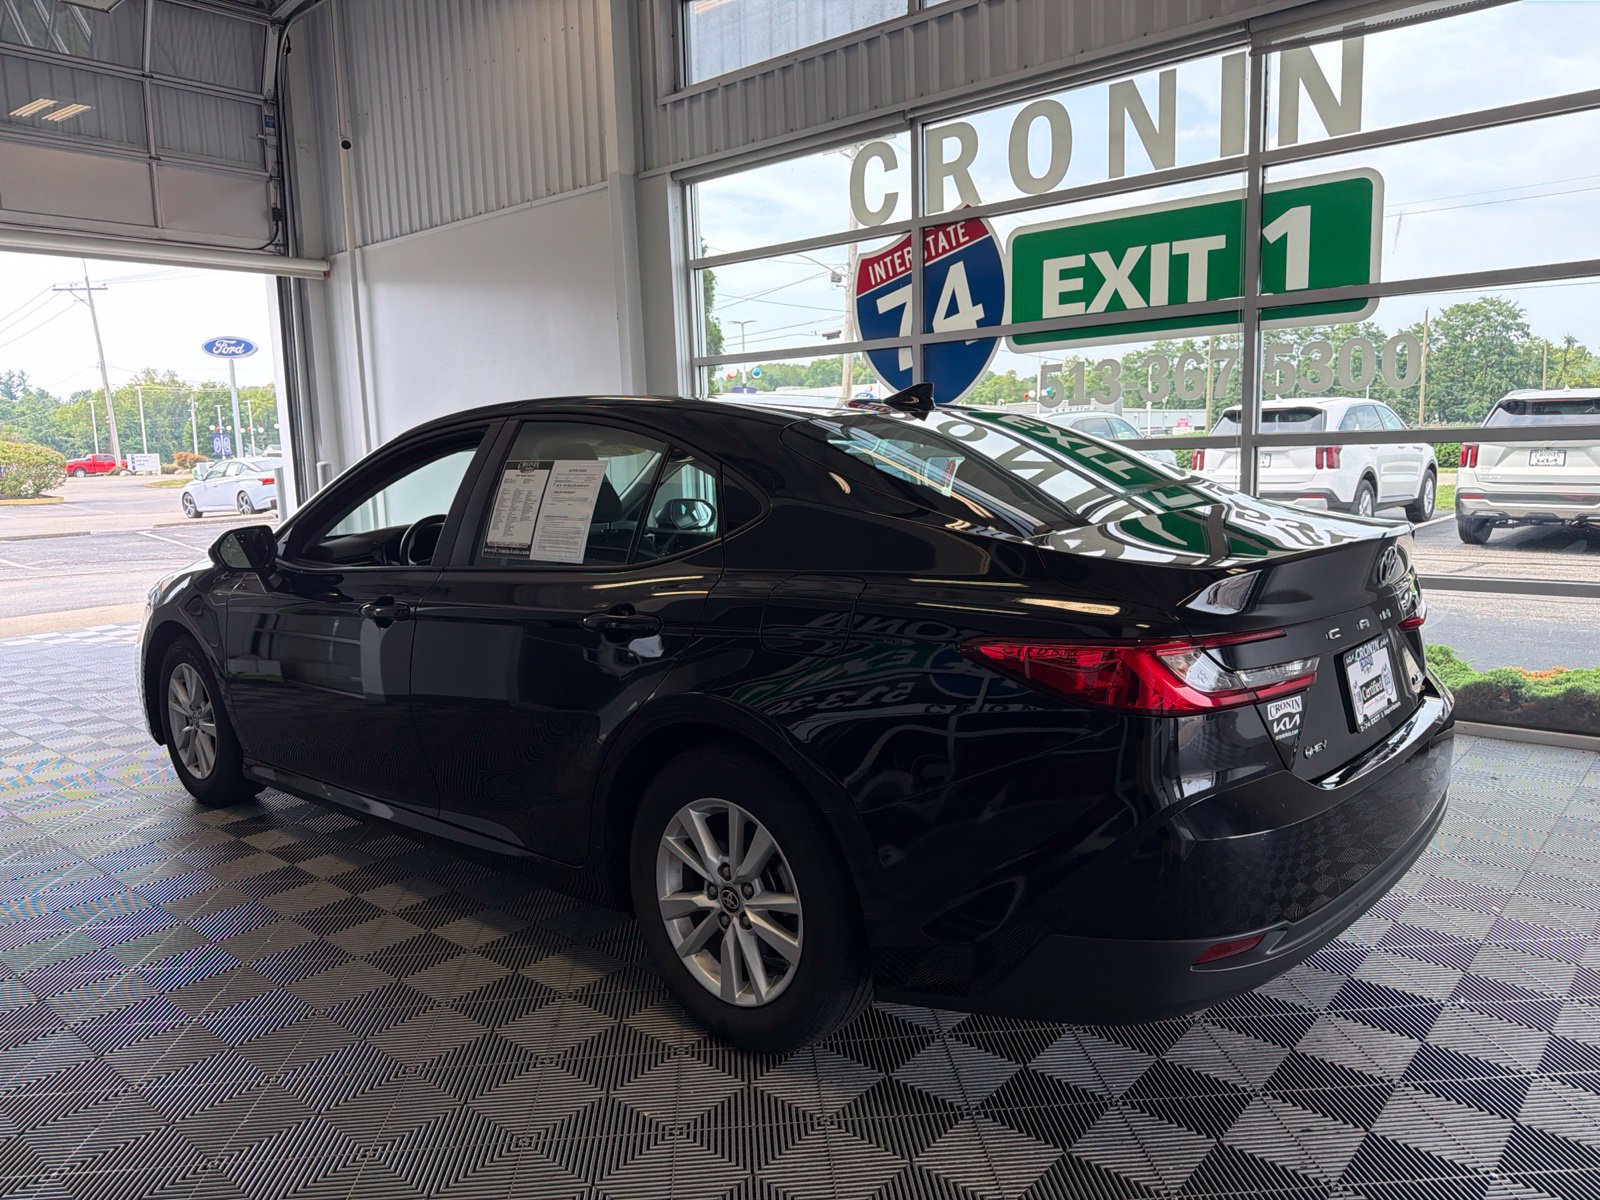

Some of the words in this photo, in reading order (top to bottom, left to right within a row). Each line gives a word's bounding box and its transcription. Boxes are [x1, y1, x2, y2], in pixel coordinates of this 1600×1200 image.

[849, 22, 1365, 227] CRONIN
[868, 221, 970, 285] INTERTATE
[1042, 234, 1226, 318] EXIT
[1261, 205, 1312, 292] 1
[213, 340, 246, 354] Ford
[876, 261, 985, 372] 74
[1269, 697, 1301, 719] CRONIN
[1273, 713, 1300, 734] KIA
